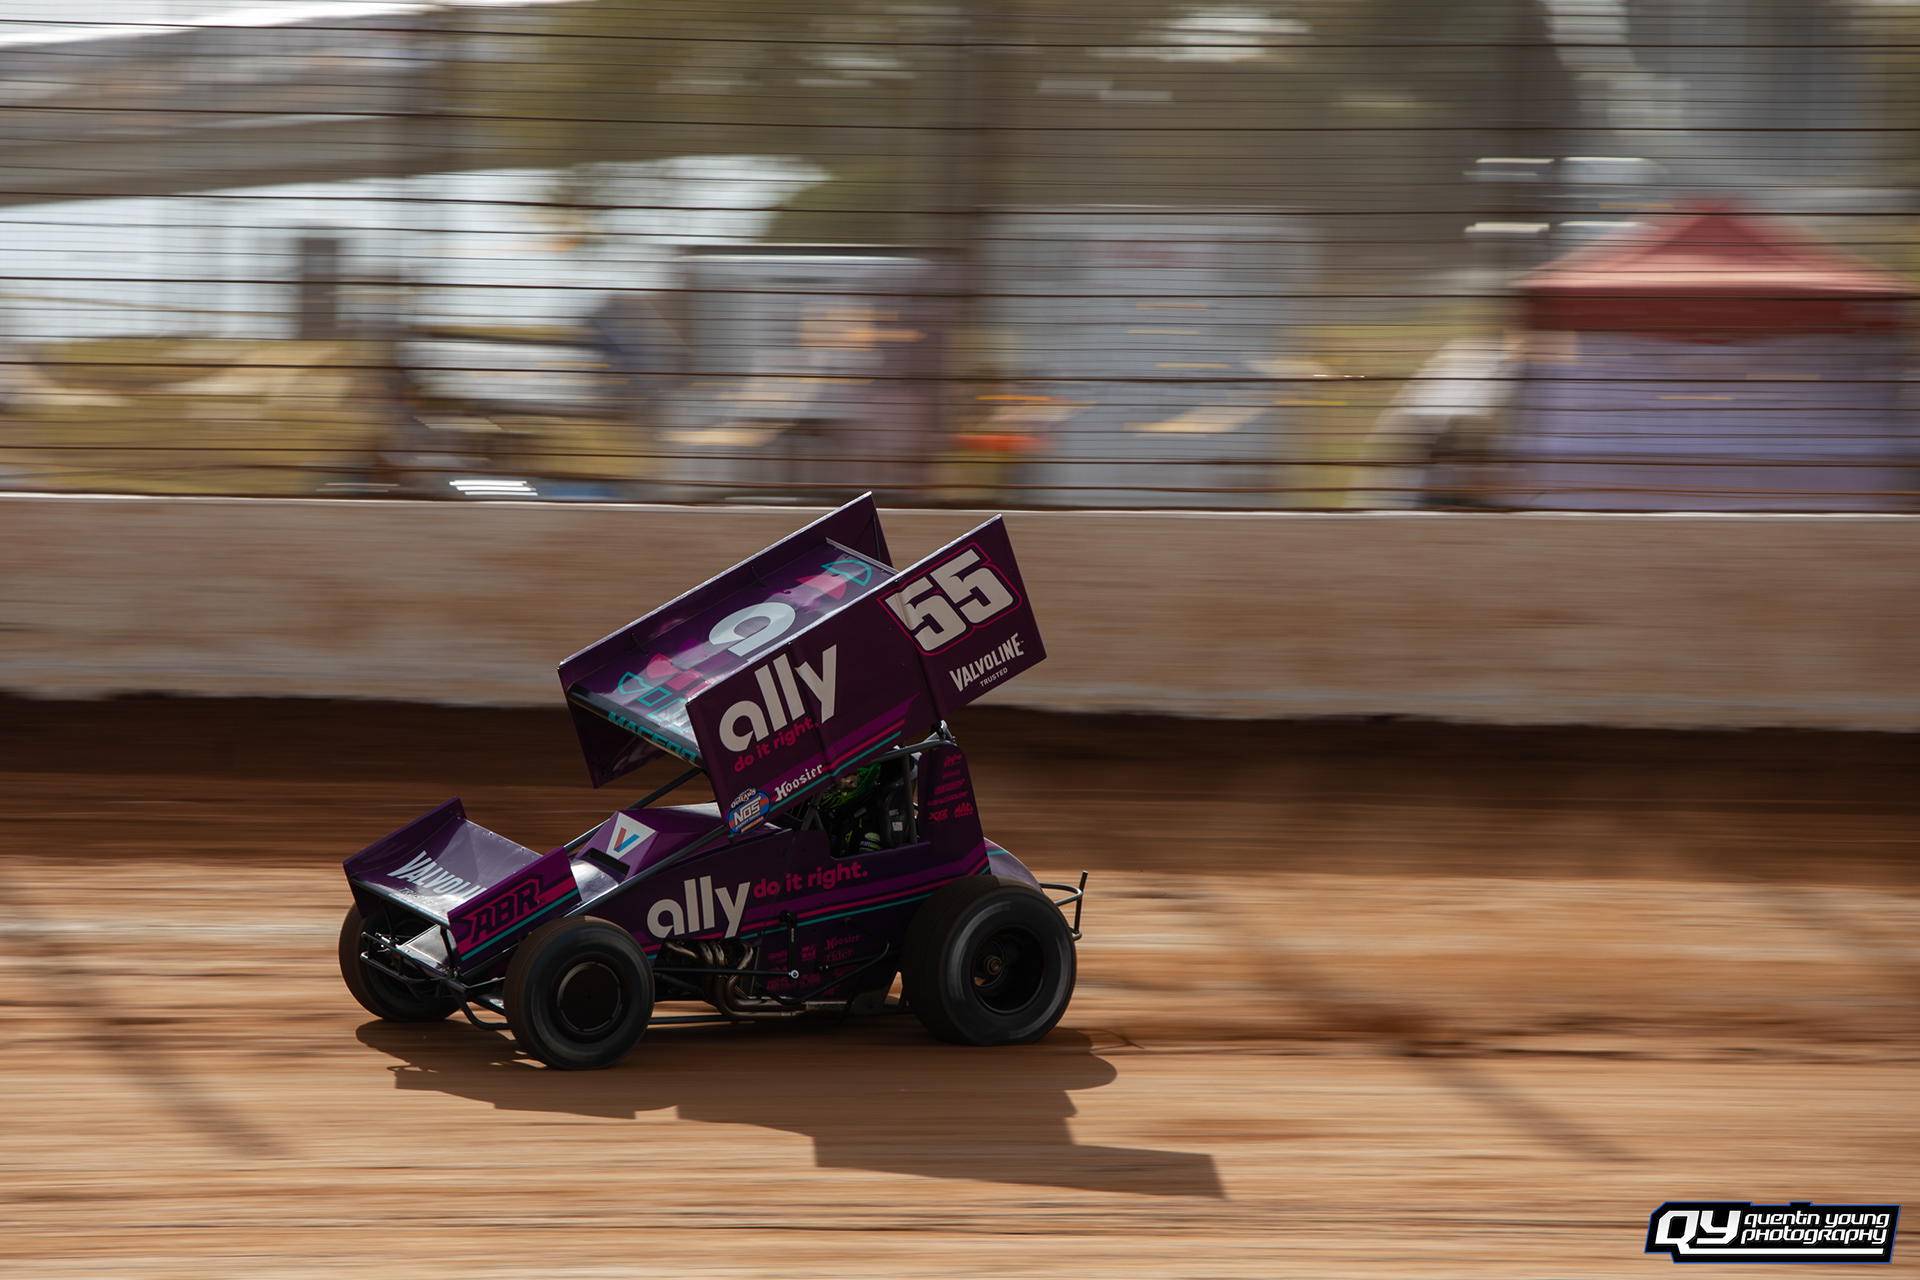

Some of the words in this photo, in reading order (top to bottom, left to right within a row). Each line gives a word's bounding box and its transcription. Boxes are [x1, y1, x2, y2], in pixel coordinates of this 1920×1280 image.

[885, 549, 1013, 651] 55
[949, 633, 1024, 692] VALVOLINE
[980, 667, 1008, 687] TRUSTED
[719, 644, 837, 752] ally
[734, 755, 754, 772] do
[755, 743, 771, 759] it
[773, 717, 819, 746] right.
[733, 794, 762, 826] NOS
[774, 764, 823, 802] Hoosier
[386, 850, 488, 901] VALVOLI
[753, 878, 780, 898] do
[785, 873, 803, 892] it
[808, 861, 868, 889] right.
[468, 881, 540, 945] ABR
[647, 875, 751, 938] ally
